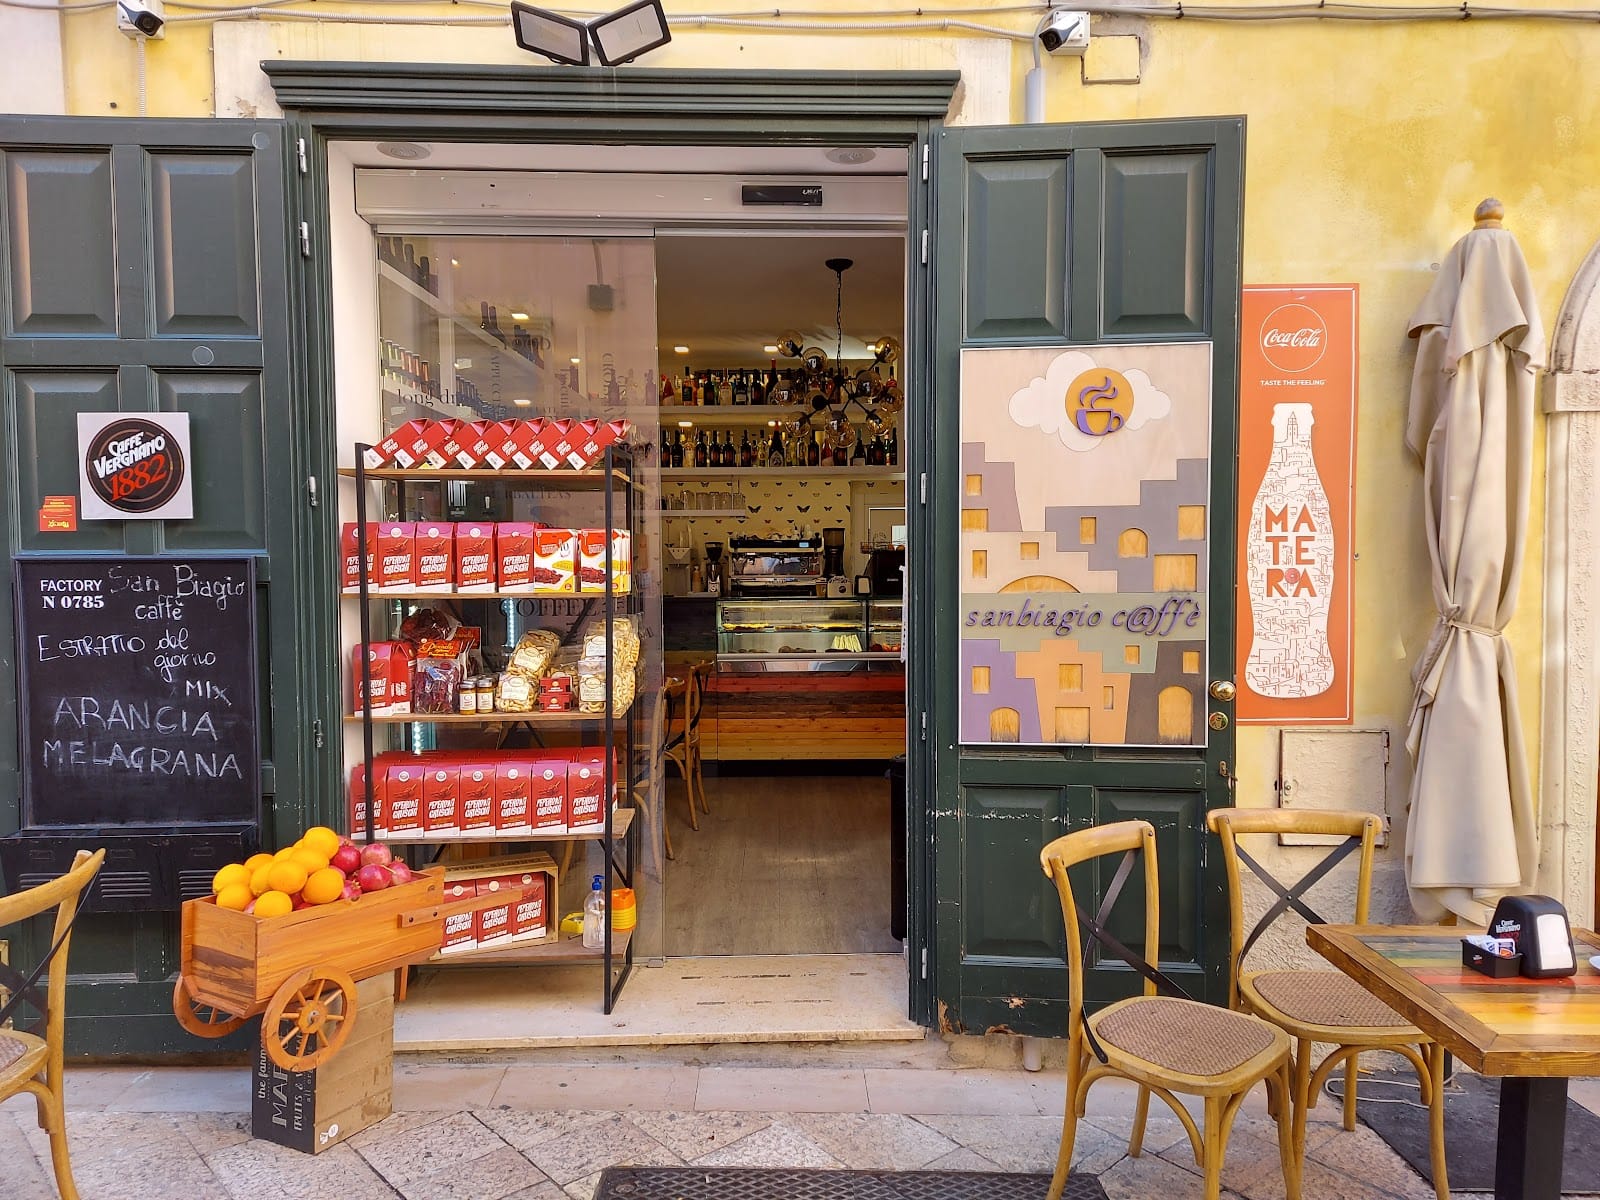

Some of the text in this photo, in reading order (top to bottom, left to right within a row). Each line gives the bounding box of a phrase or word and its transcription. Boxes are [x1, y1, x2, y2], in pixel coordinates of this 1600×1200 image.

[1264, 328, 1323, 348] Coca-Cola
[396, 389, 434, 408] long
[94, 435, 165, 479] VERGNANO
[109, 453, 168, 502] 1882
[1265, 503, 1317, 533] MA
[1265, 535, 1315, 565] TE
[40, 579, 103, 592] FACTORY
[108, 564, 246, 611] San Biagio
[1266, 568, 1317, 597] RA
[42, 595, 105, 609] N 0785
[965, 596, 1202, 637] sanbiagio c@ffè
[154, 627, 189, 651] del
[153, 651, 216, 683] giorno
[54, 696, 219, 742] ARANCIA
[43, 738, 243, 780] MELAGRANA
[258, 1081, 266, 1099] the
[293, 1094, 303, 1131] FRUITS
